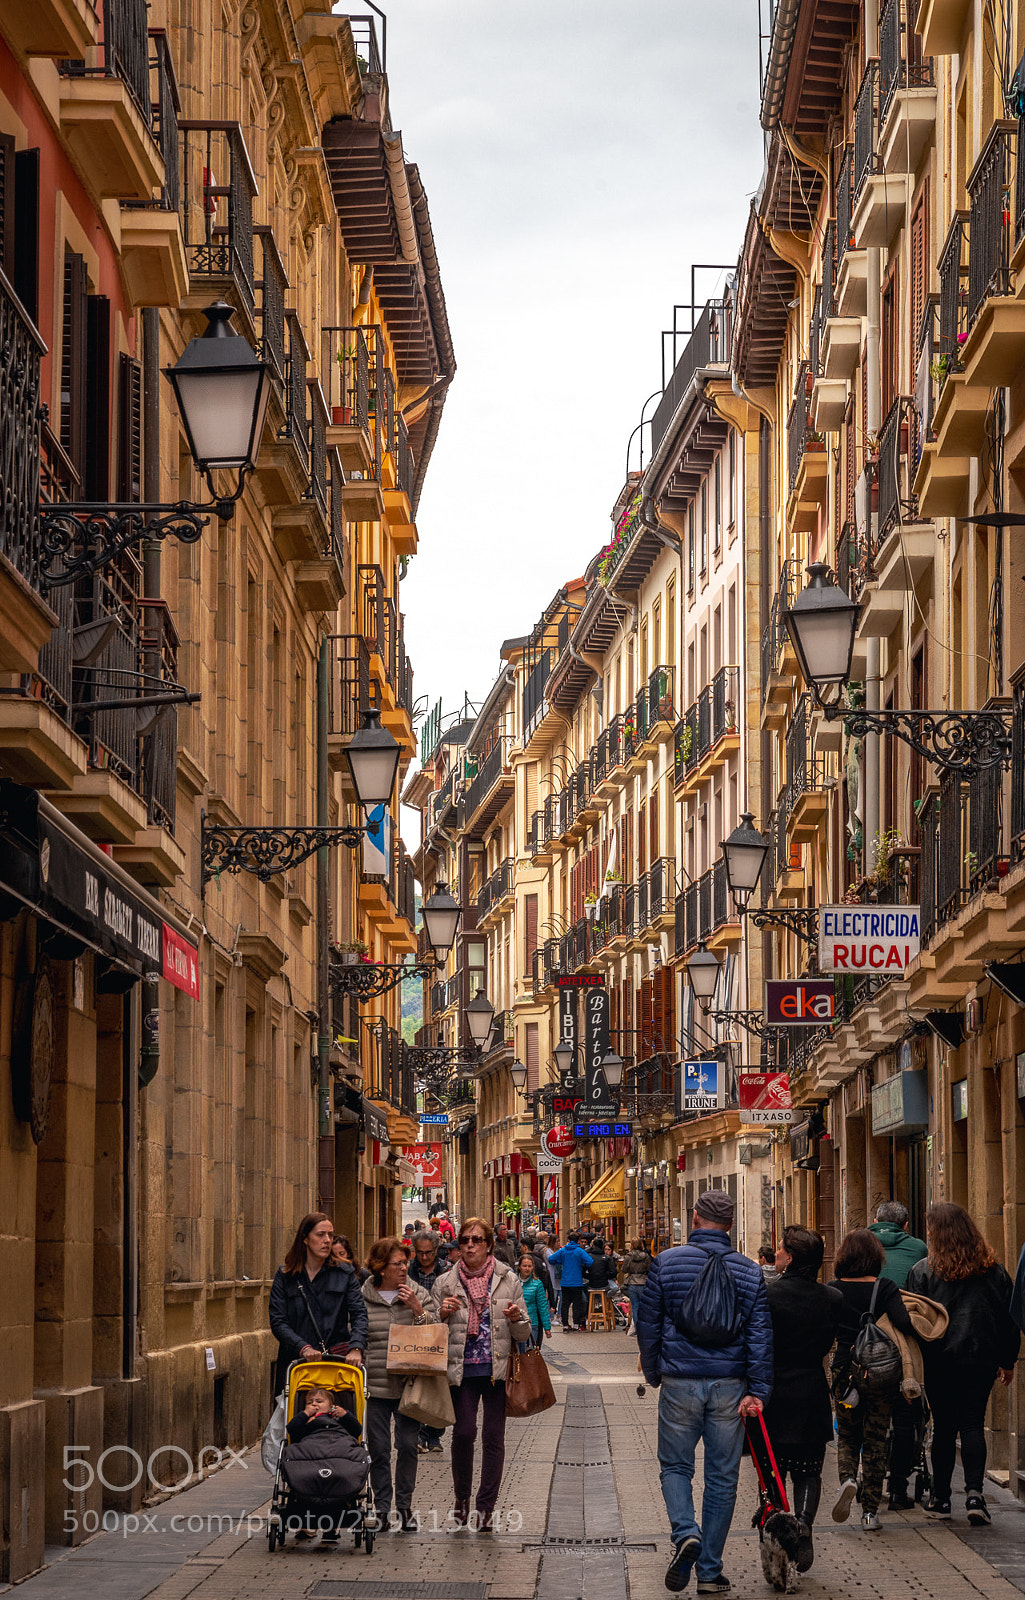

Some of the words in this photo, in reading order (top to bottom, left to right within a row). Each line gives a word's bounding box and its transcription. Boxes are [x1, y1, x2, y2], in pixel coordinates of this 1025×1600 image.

[556, 976, 604, 986] JATETXEA
[590, 995, 604, 1099] Bartolo
[688, 1098, 716, 1108] IRUNE
[752, 1112, 792, 1121] ITXASO
[588, 1124, 610, 1136] AND
